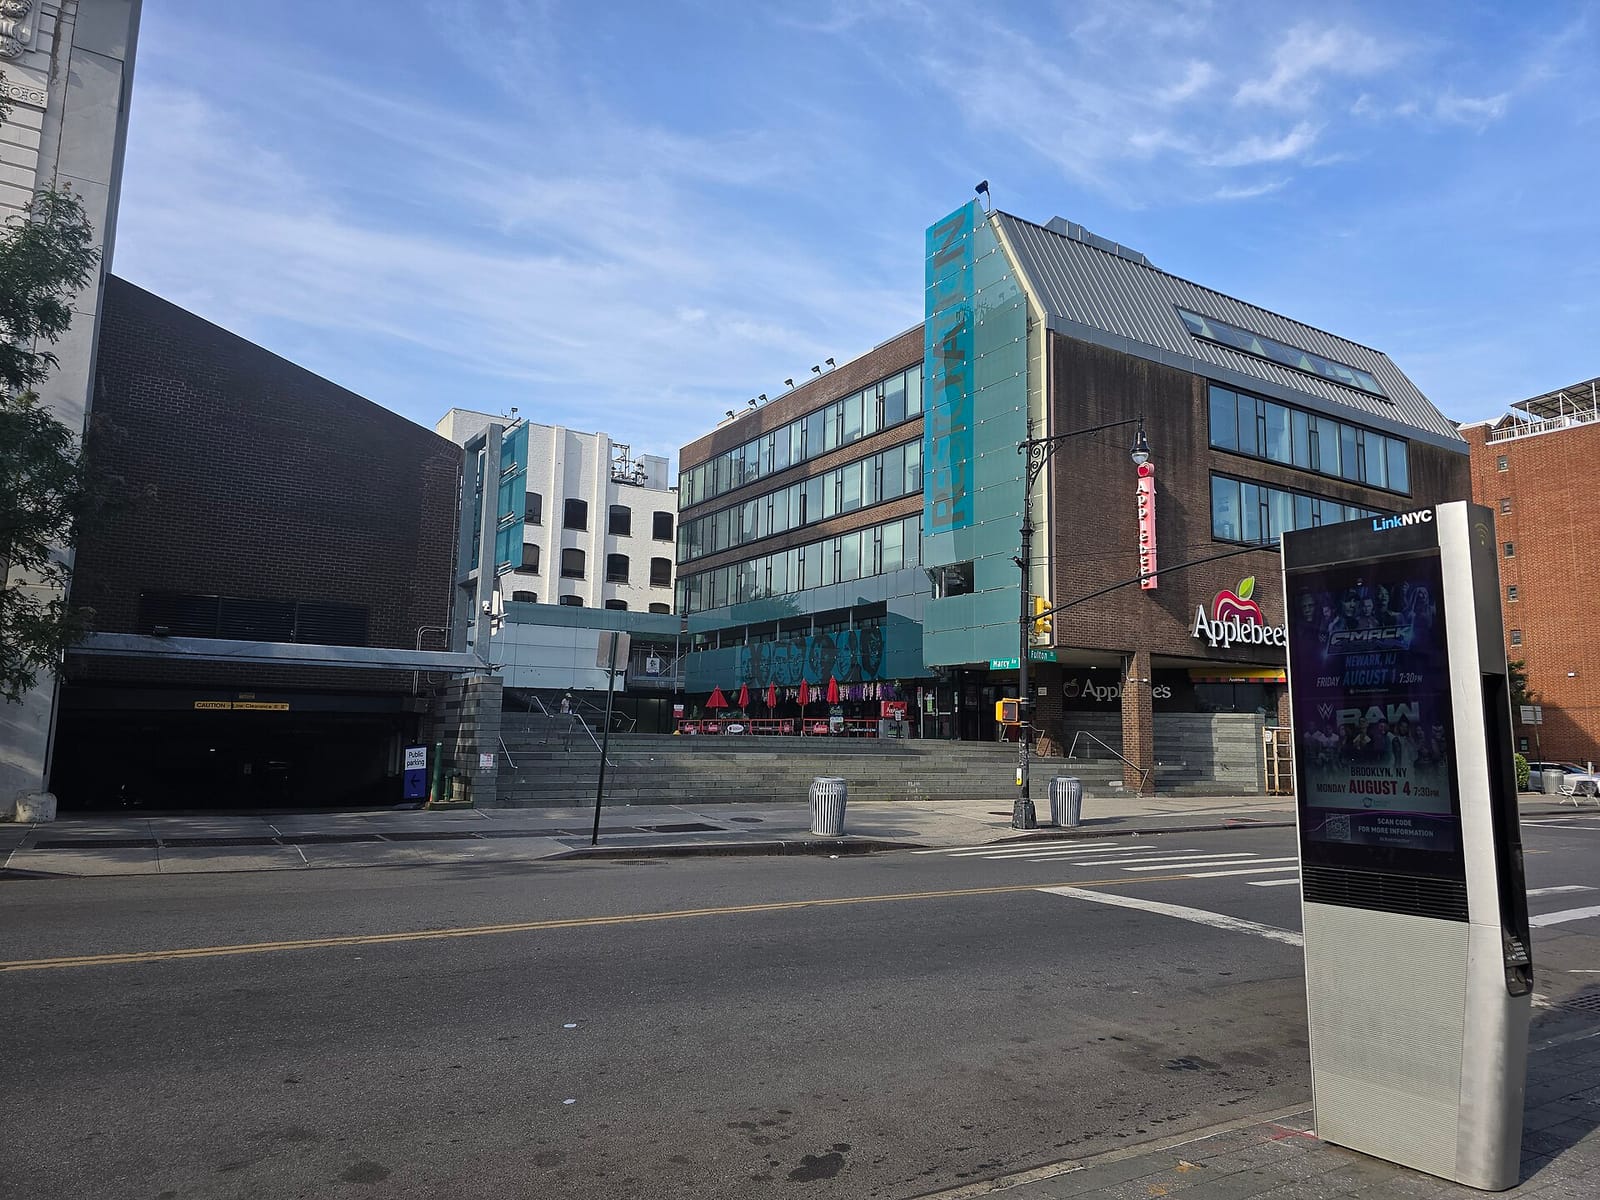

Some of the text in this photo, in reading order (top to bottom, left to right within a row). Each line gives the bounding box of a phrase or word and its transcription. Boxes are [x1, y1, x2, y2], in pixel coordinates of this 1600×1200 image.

[1373, 509, 1432, 531] LinkNYC
[1136, 482, 1150, 587] Applebees
[1031, 650, 1048, 660] Fulton
[992, 659, 1010, 669] Marcy
[1316, 675, 1341, 687] FRIDAY
[1343, 669, 1389, 686] AUGUST
[1081, 678, 1172, 702] Apple's
[1336, 702, 1420, 728] RAW
[406, 759, 425, 768] parking
[1396, 767, 1407, 778] NY
[1316, 783, 1346, 793] MONDAY
[1349, 780, 1398, 796] AUGUST
[1402, 781, 1411, 796] 4
[1377, 817, 1412, 827] SCAN CODE
[1358, 825, 1434, 837] FOR MORE INFORMATION
